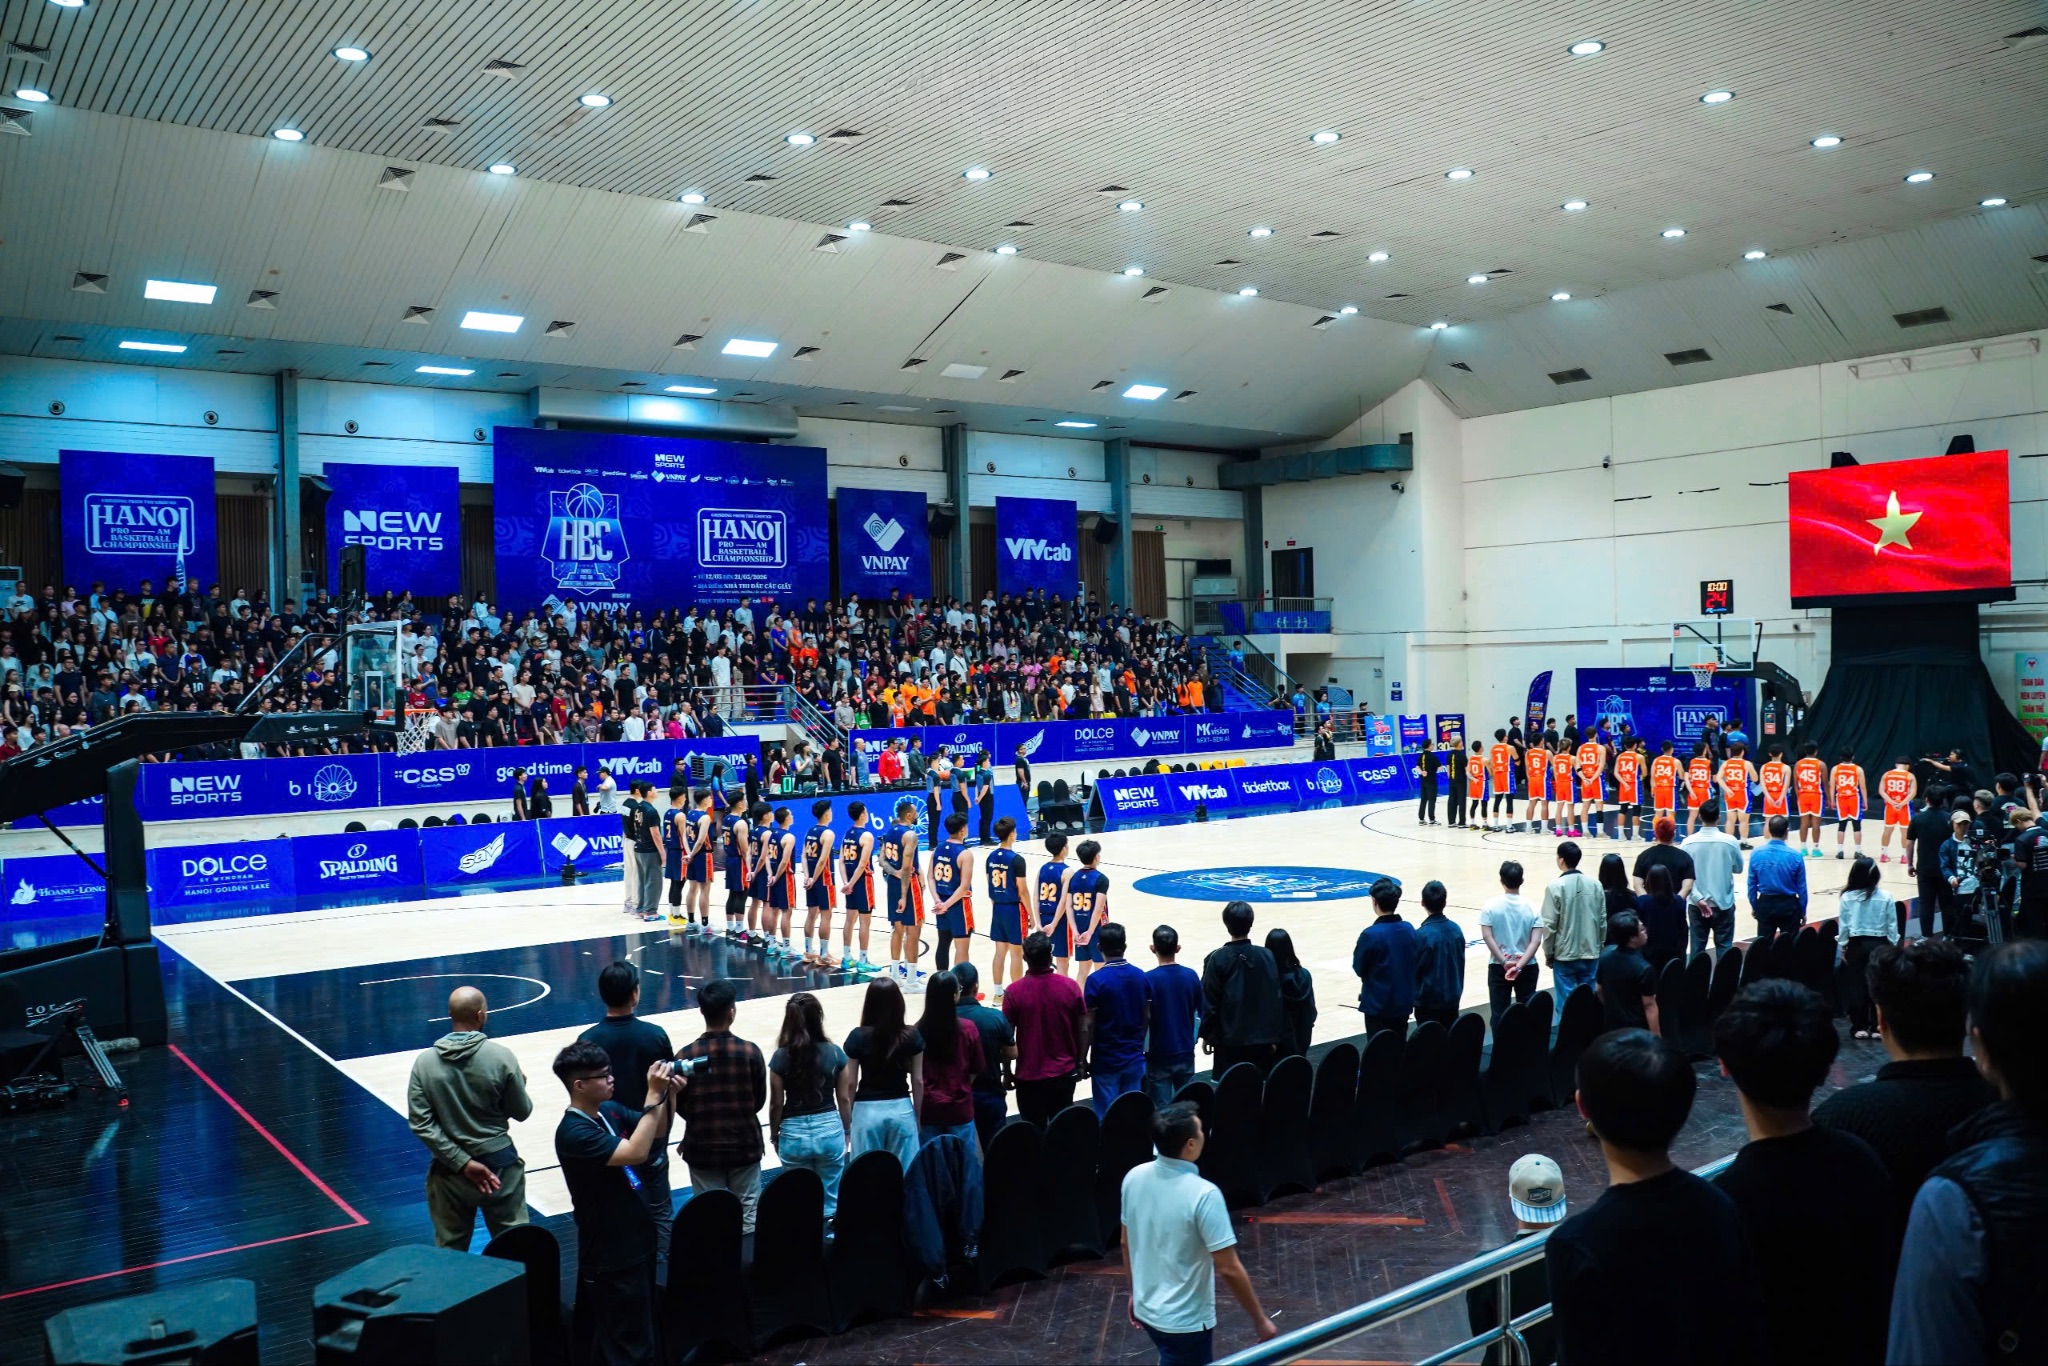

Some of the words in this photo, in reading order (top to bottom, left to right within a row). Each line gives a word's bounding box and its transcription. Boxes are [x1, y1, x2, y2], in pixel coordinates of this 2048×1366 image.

[91, 504, 190, 550] HANOI
[344, 510, 442, 534] NEW
[110, 534, 170, 542] BASKETBALL
[344, 536, 444, 551] SPORTS
[558, 520, 613, 562] HBC
[702, 518, 782, 563] HANOI
[103, 541, 178, 550] CHAMPIONSHIP
[1004, 537, 1071, 562] VTVcab
[712, 554, 774, 563] CHAMPIONSHIP
[861, 556, 910, 570] VNPAY
[1707, 582, 1728, 591] 10:00
[1706, 592, 1726, 608] 24
[1151, 730, 1180, 740] VNPAY
[1496, 753, 1503, 763] 1
[1532, 758, 1540, 768] 6
[1581, 752, 1596, 764] 13
[598, 756, 662, 775] VTVcab
[1558, 764, 1566, 774] 8
[1620, 760, 1634, 772] 14
[1656, 765, 1672, 776] 24
[496, 762, 572, 783] godtime
[1692, 769, 1707, 780] 28
[1726, 769, 1743, 781] 33
[1765, 771, 1781, 783] 34
[1800, 769, 1816, 782] 45
[170, 774, 241, 793] NEW
[1242, 780, 1291, 794] ticketbox
[1838, 775, 1854, 787] 84
[1887, 779, 1905, 792] 98
[171, 791, 242, 804] SPORTS
[1114, 786, 1154, 801] NEW
[1179, 784, 1227, 801] VTVcab
[1117, 798, 1159, 810] SPORTS
[320, 854, 398, 879] SPALDING
[992, 869, 1007, 889] 81
[1040, 882, 1057, 902] 92
[1073, 892, 1092, 911] 95
